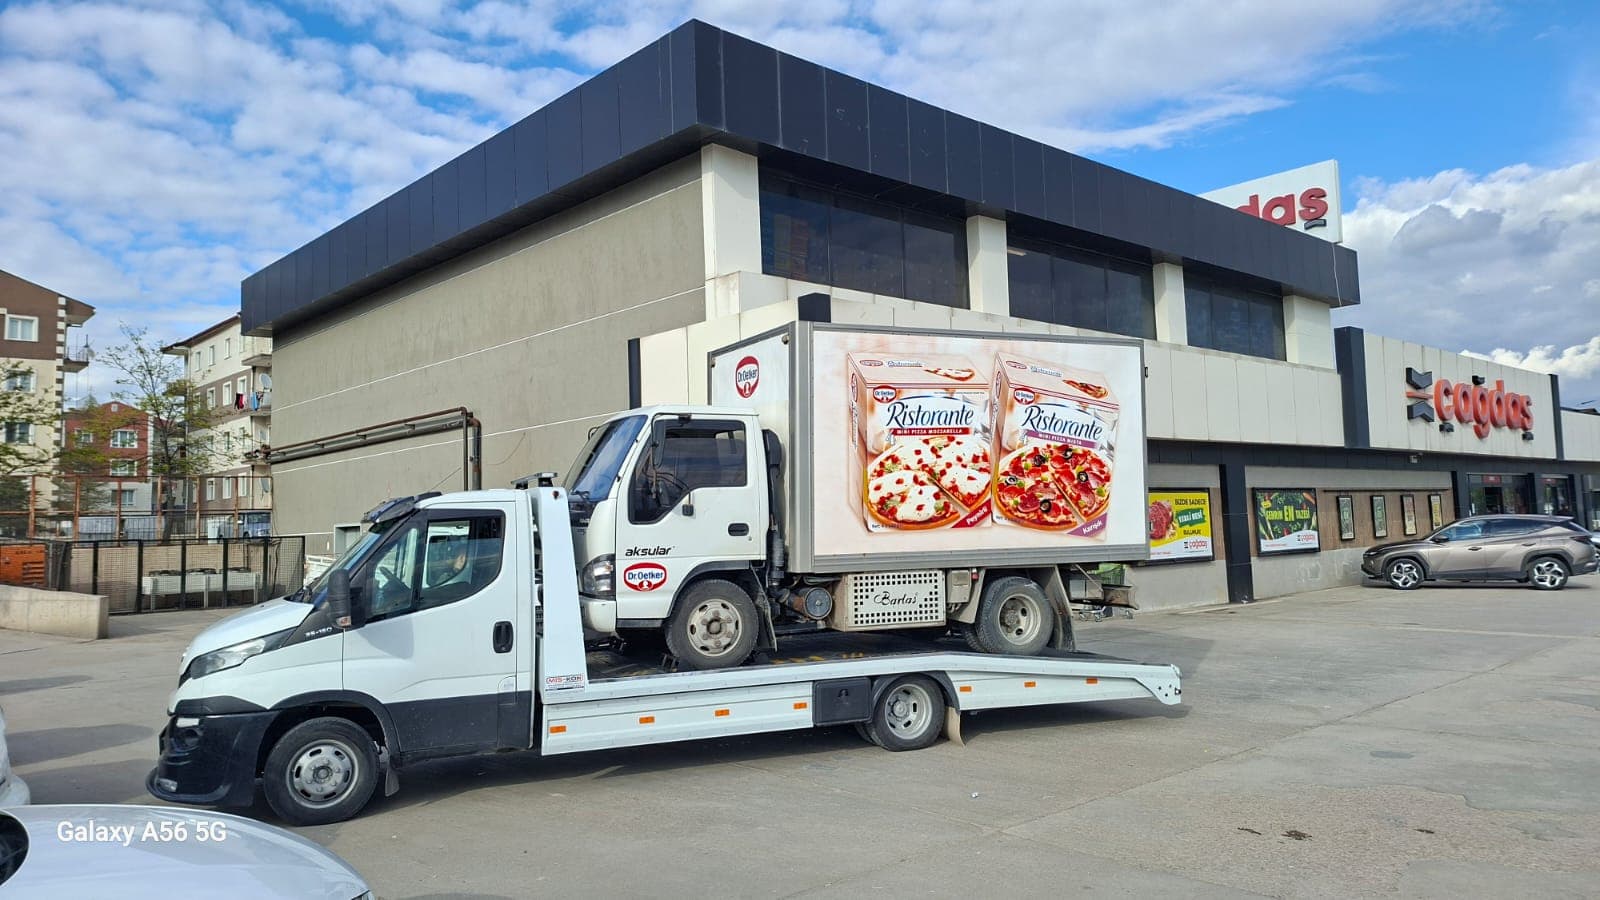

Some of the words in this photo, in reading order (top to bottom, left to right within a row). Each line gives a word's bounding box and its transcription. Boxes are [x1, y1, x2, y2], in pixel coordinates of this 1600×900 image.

[886, 400, 974, 428] Ristorante
[1433, 375, 1534, 440] çağdaş
[1021, 404, 1103, 440] Ristorante
[1284, 505, 1295, 522] EN
[625, 546, 672, 557] aksular
[627, 570, 664, 580] Dr.Oetker
